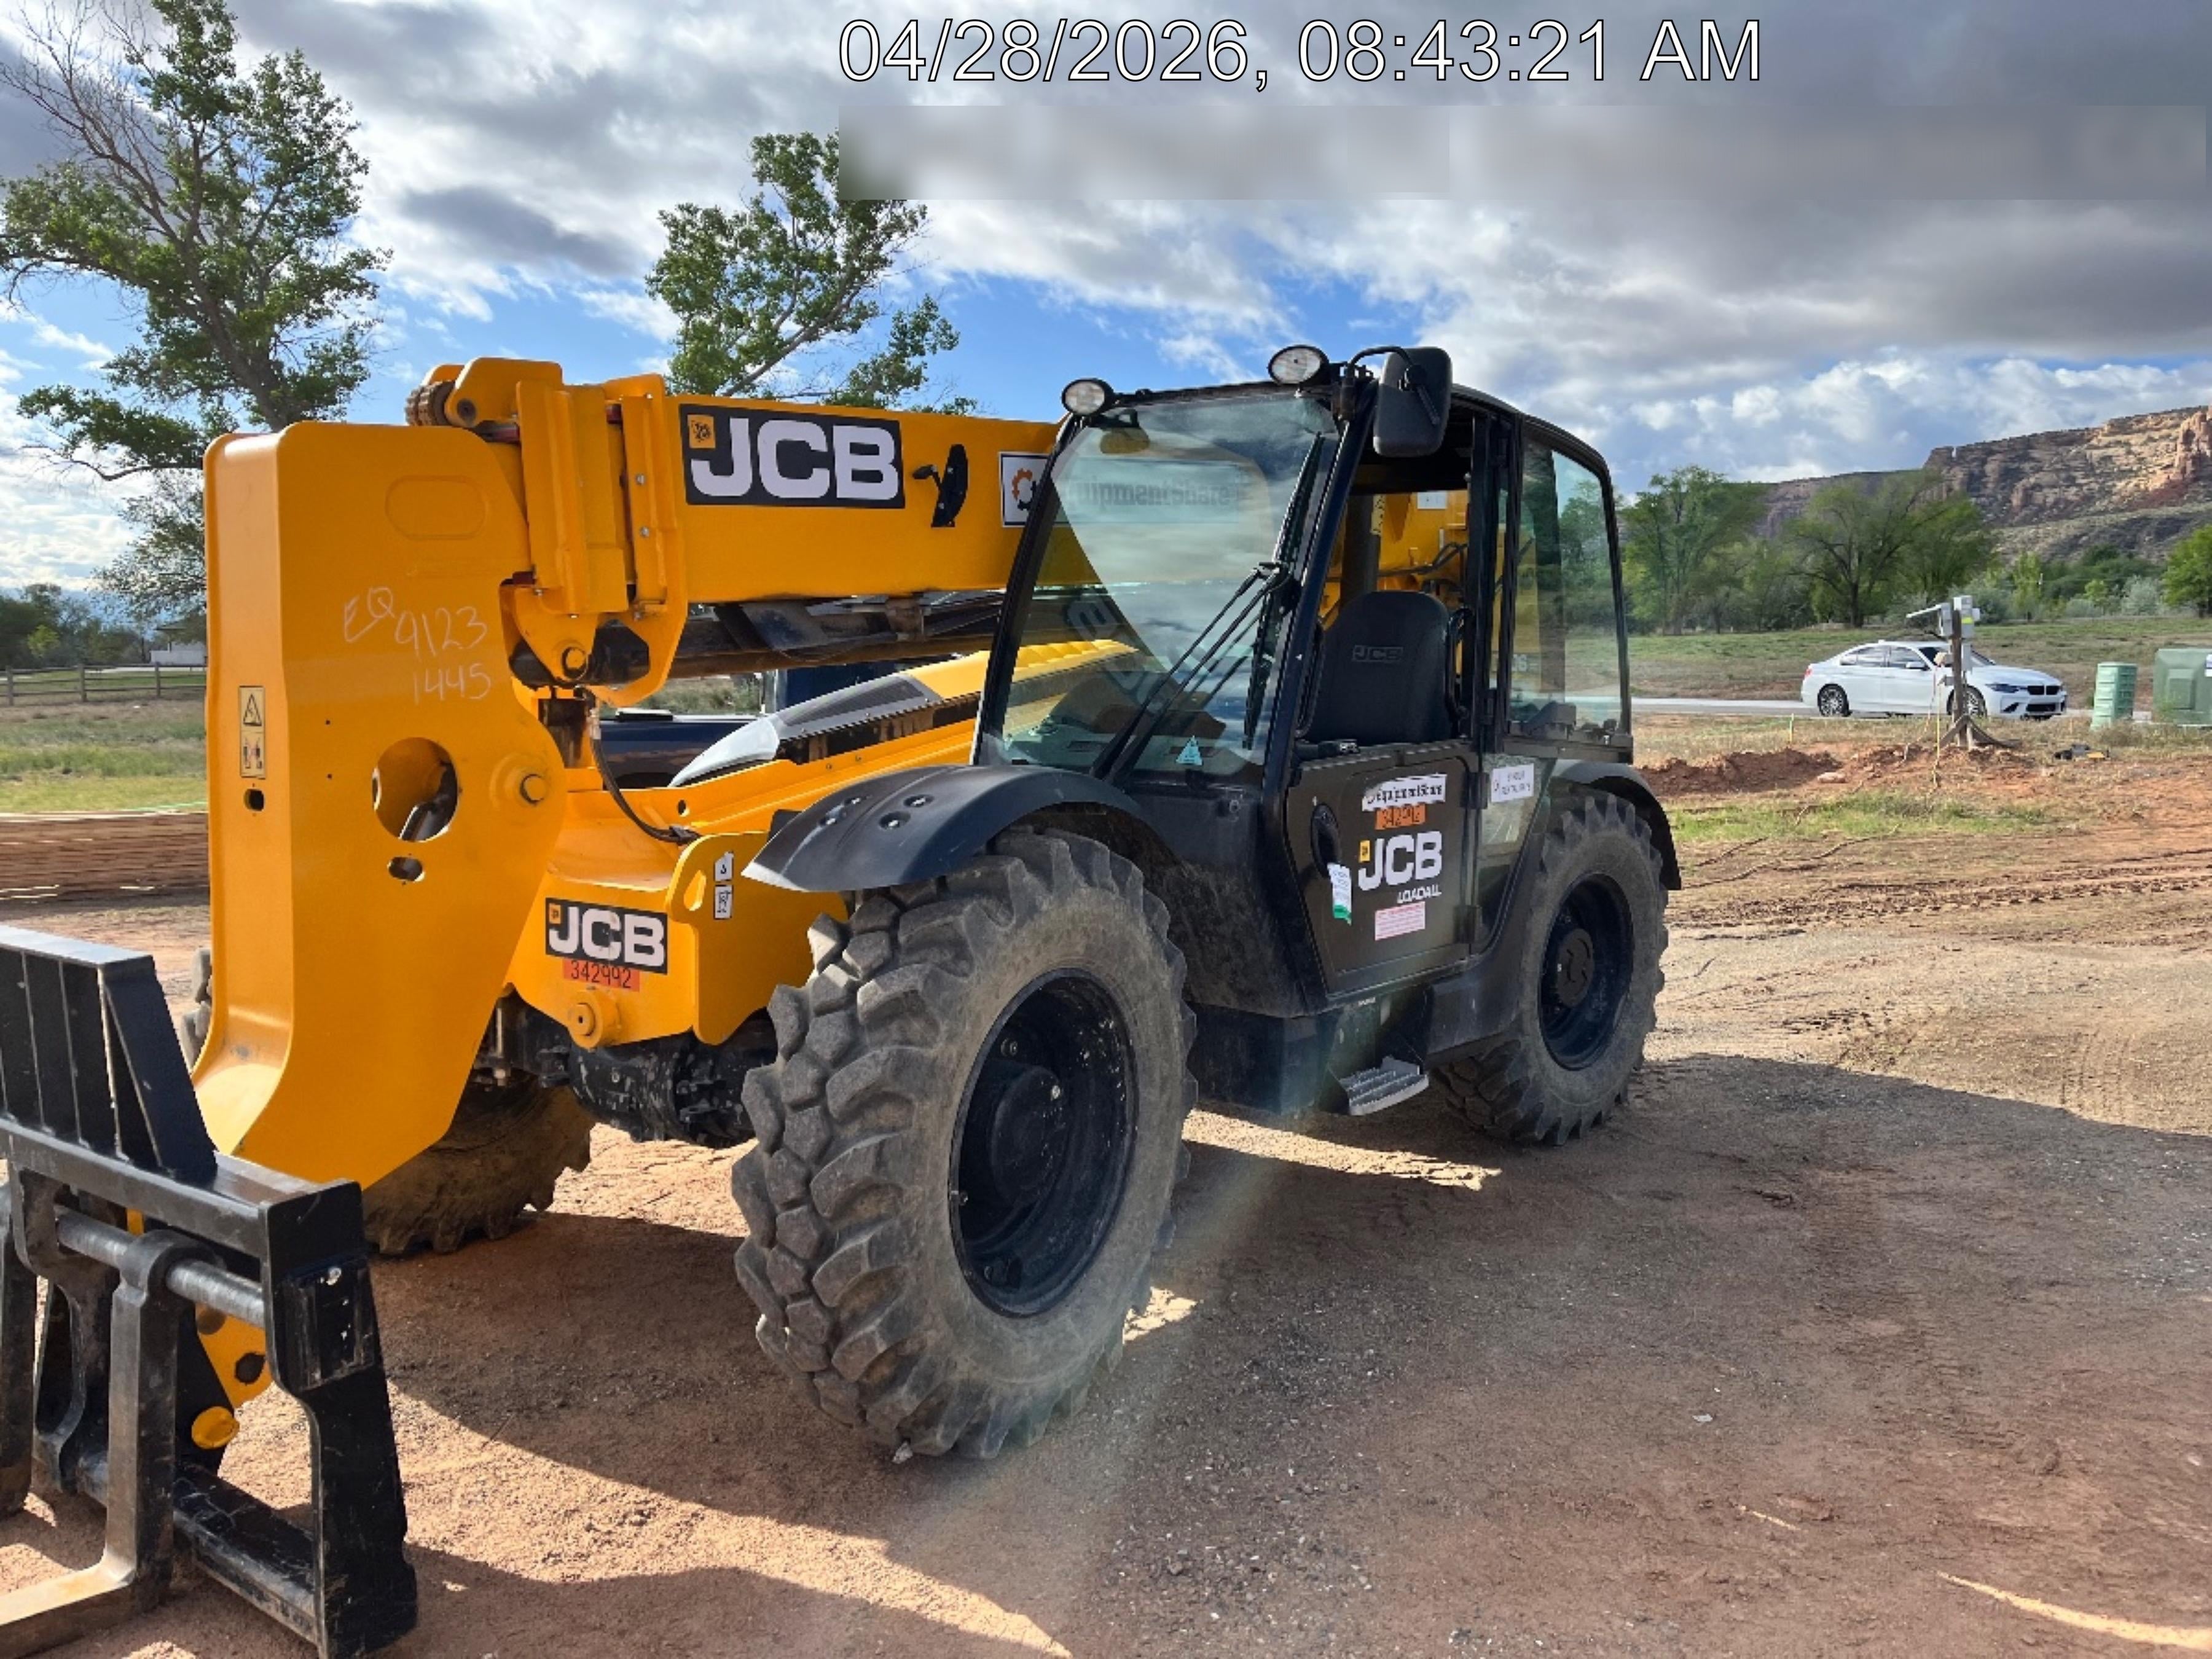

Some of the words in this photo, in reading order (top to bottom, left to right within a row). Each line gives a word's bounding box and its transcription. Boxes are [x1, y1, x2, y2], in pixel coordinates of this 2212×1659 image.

[690, 417, 900, 500] JCB
[343, 586, 395, 643] EQ
[395, 606, 489, 662] 9123
[1354, 646, 1402, 661] JCB
[414, 662, 492, 705] 1445
[1358, 830, 1443, 890] JCB
[1397, 884, 1442, 903] LOADALL
[549, 906, 665, 967] JCB
[570, 960, 632, 989] 342992
